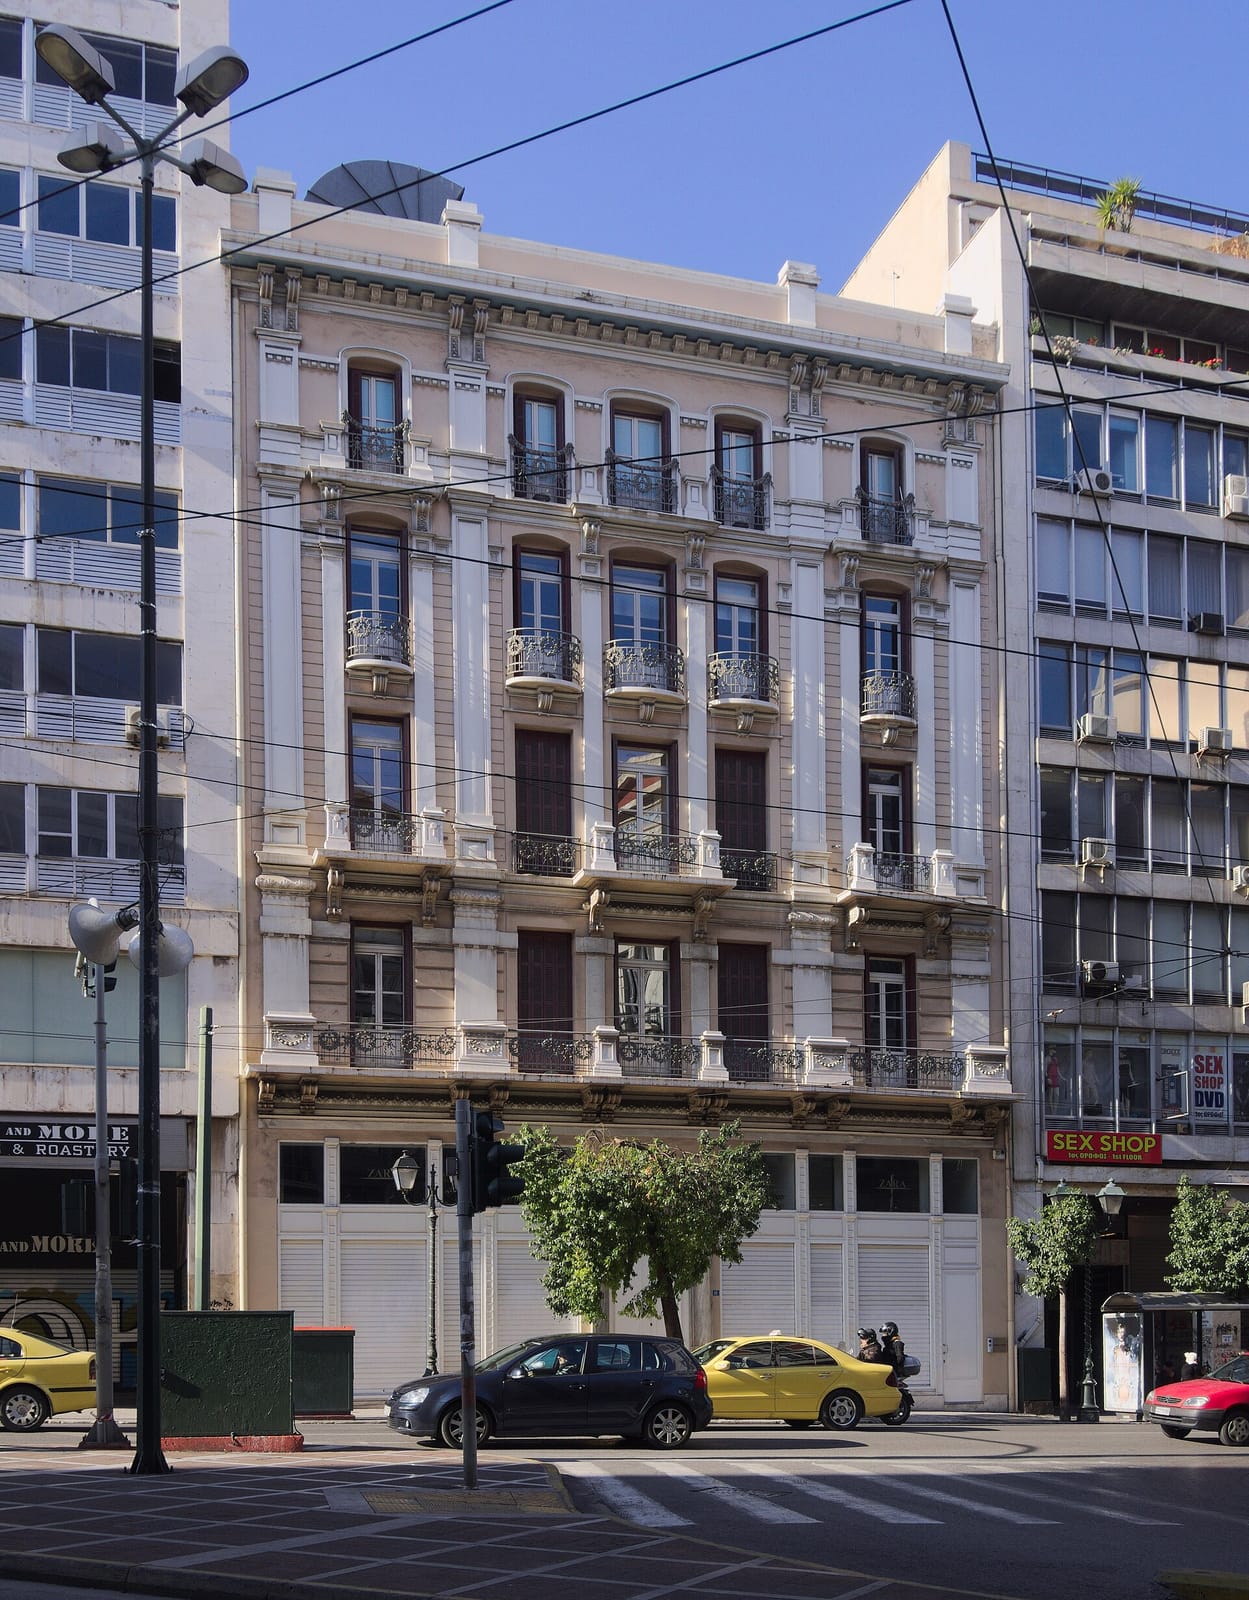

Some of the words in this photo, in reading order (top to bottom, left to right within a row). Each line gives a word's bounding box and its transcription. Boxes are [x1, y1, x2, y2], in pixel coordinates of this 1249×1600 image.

[1194, 1054, 1223, 1074] SEX
[1194, 1076, 1223, 1089] SHOP
[1194, 1090, 1224, 1108] DVD
[5, 1127, 31, 1136] AND
[12, 1143, 24, 1155] &
[36, 1144, 130, 1157] ROASTRY
[1053, 1133, 1094, 1151] SEX
[1100, 1135, 1156, 1153] SHOP
[0, 1241, 29, 1252] AND
